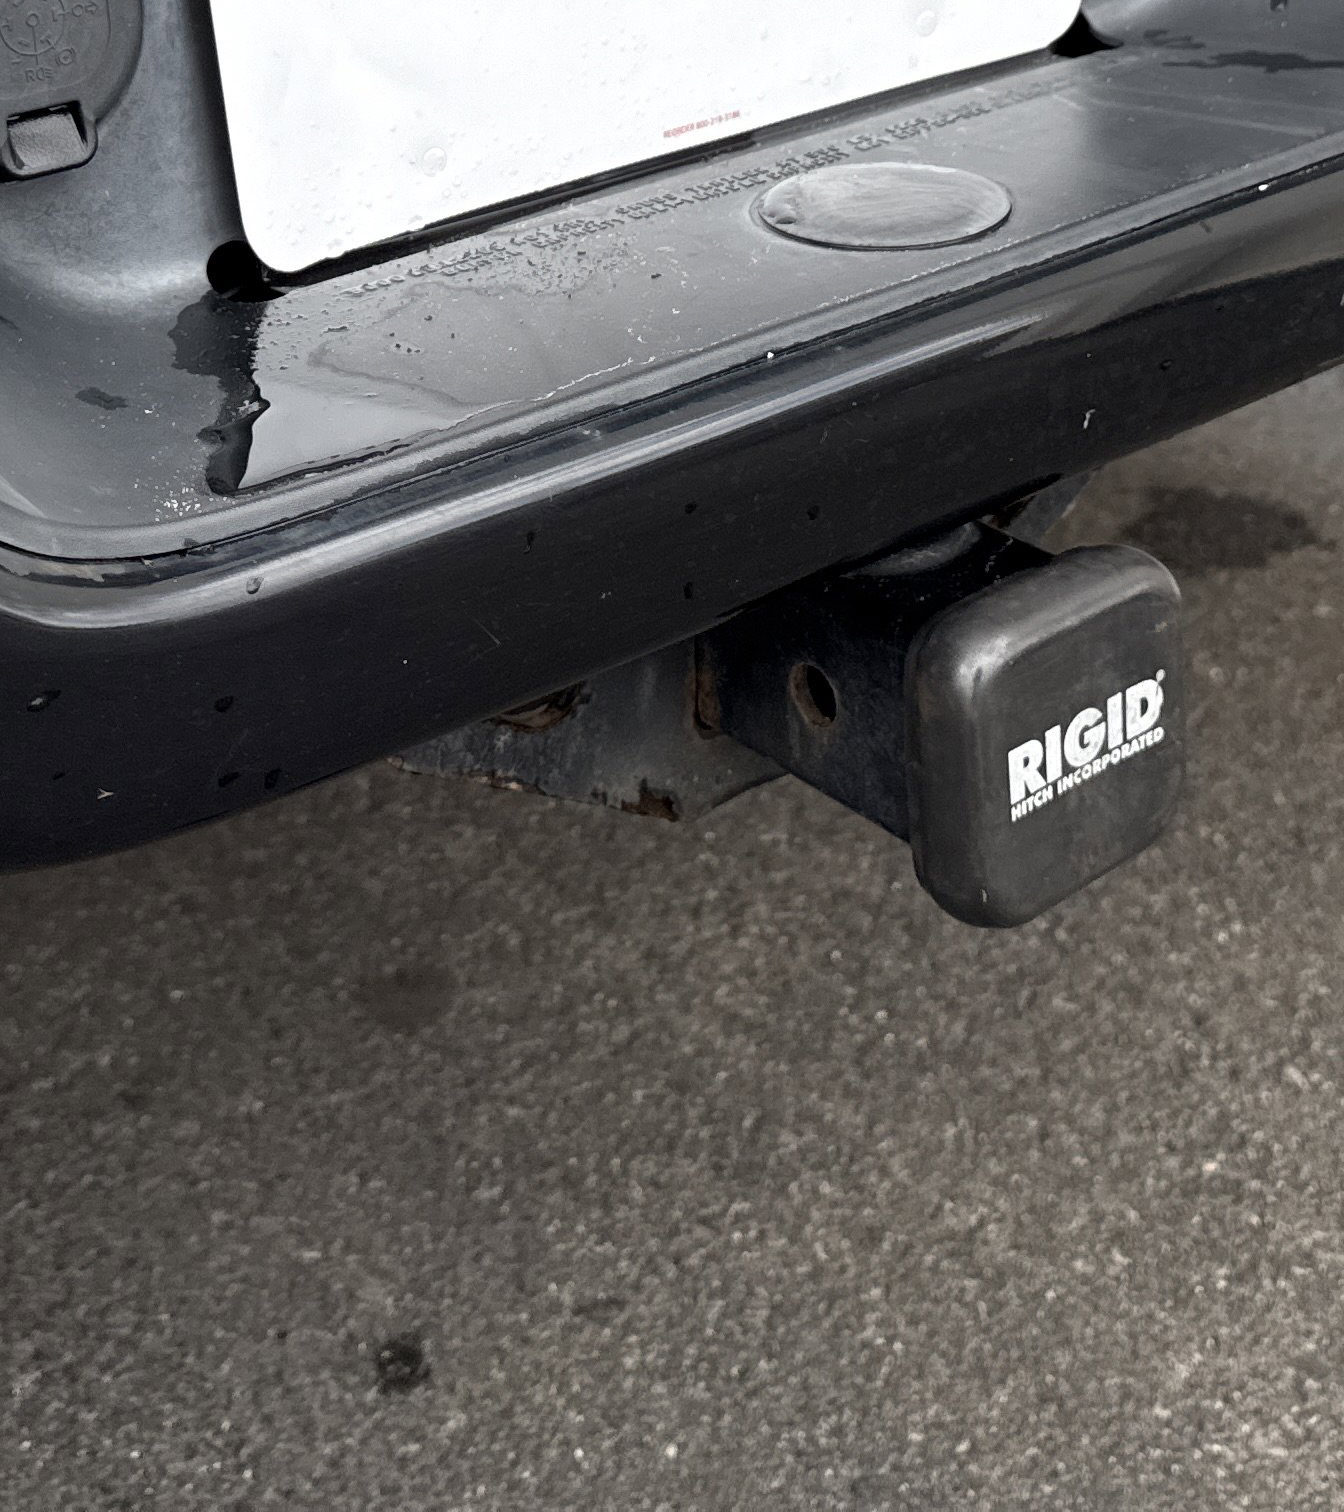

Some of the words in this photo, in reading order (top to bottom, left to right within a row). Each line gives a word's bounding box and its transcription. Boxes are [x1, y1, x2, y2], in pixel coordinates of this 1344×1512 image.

[1007, 678, 1165, 805] RIGID
[1010, 784, 1054, 823] HITCH
[1056, 725, 1166, 797] INCORPORATED
